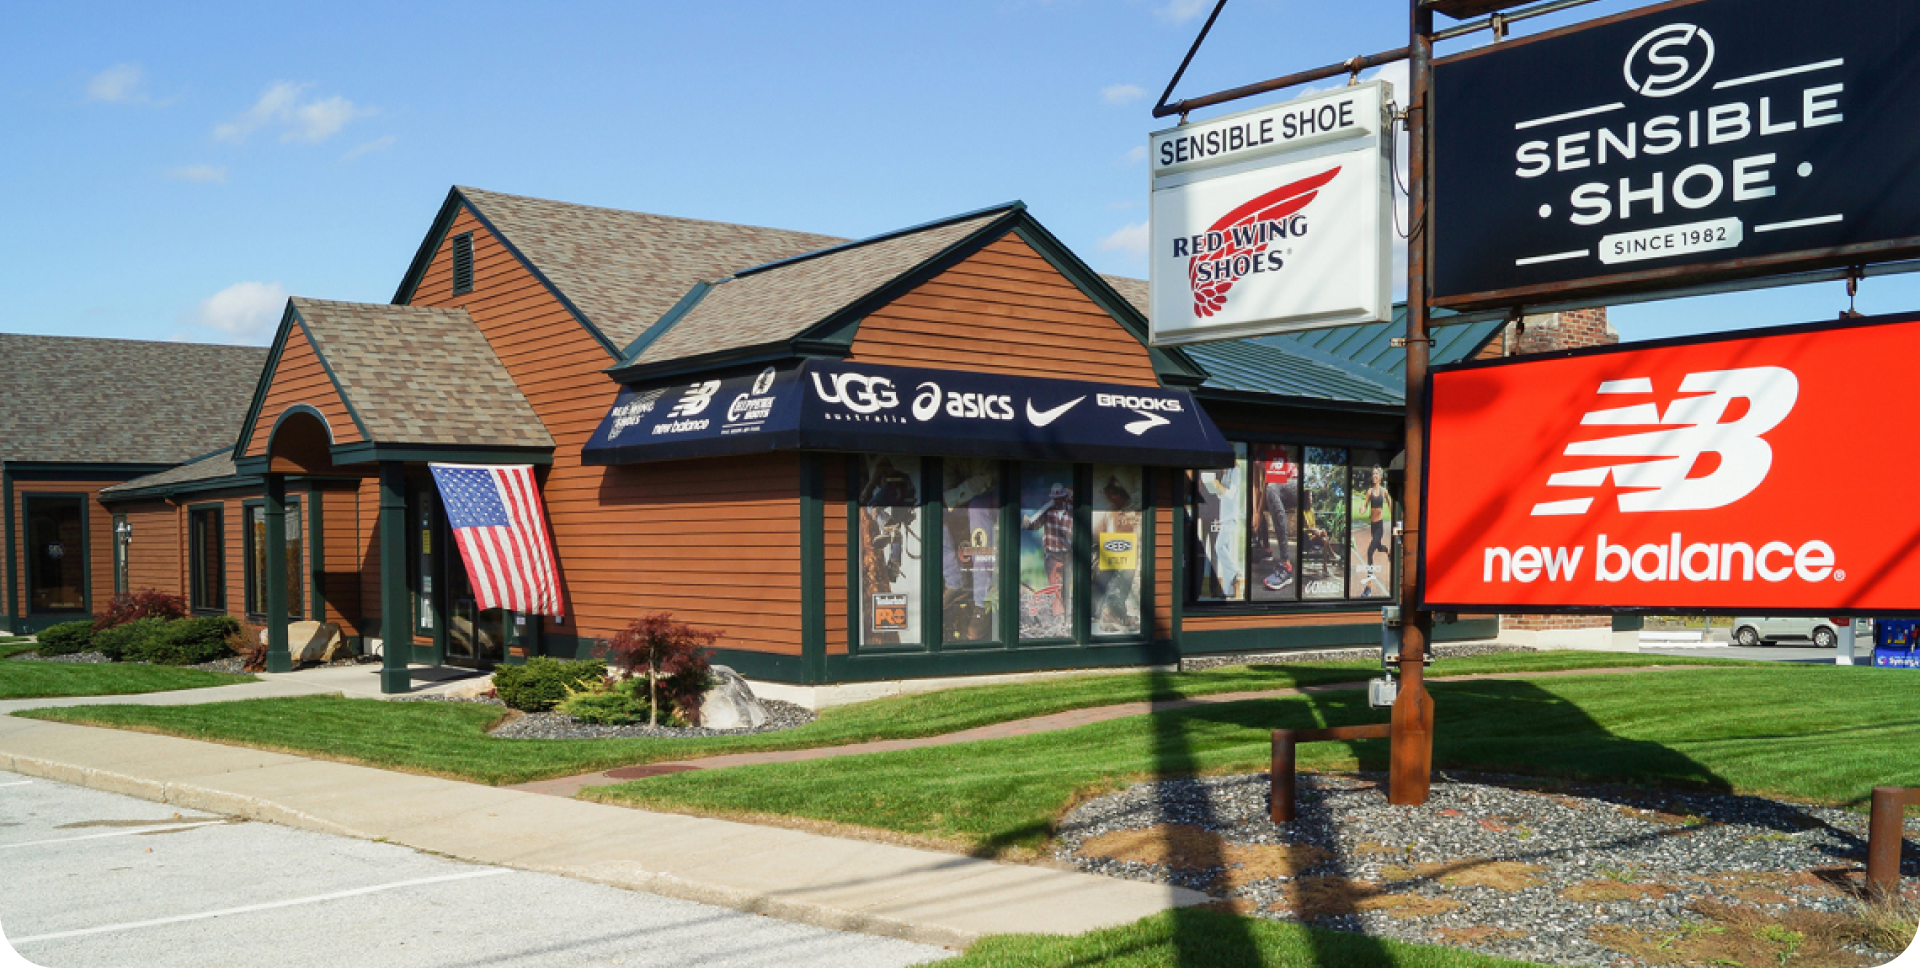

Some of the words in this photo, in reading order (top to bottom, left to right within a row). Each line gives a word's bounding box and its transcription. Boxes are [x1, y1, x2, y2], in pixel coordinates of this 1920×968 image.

[1161, 118, 1274, 166] SENSIBLE
[1282, 100, 1354, 139] SHOE
[1515, 83, 1844, 179] SENSIBLE
[1569, 153, 1776, 225] SHOE
[1173, 231, 1222, 258] RED
[1232, 215, 1308, 247] WING
[1614, 233, 1675, 255] SINCE
[1680, 227, 1727, 247] 1982
[1197, 250, 1284, 282] SHOES
[810, 371, 900, 413] UGG
[946, 392, 1015, 420] asics
[1096, 393, 1181, 412] BROOKS
[652, 423, 673, 434] new
[671, 418, 710, 433] balance
[1483, 545, 1584, 583] new
[1595, 532, 1836, 583] balance
